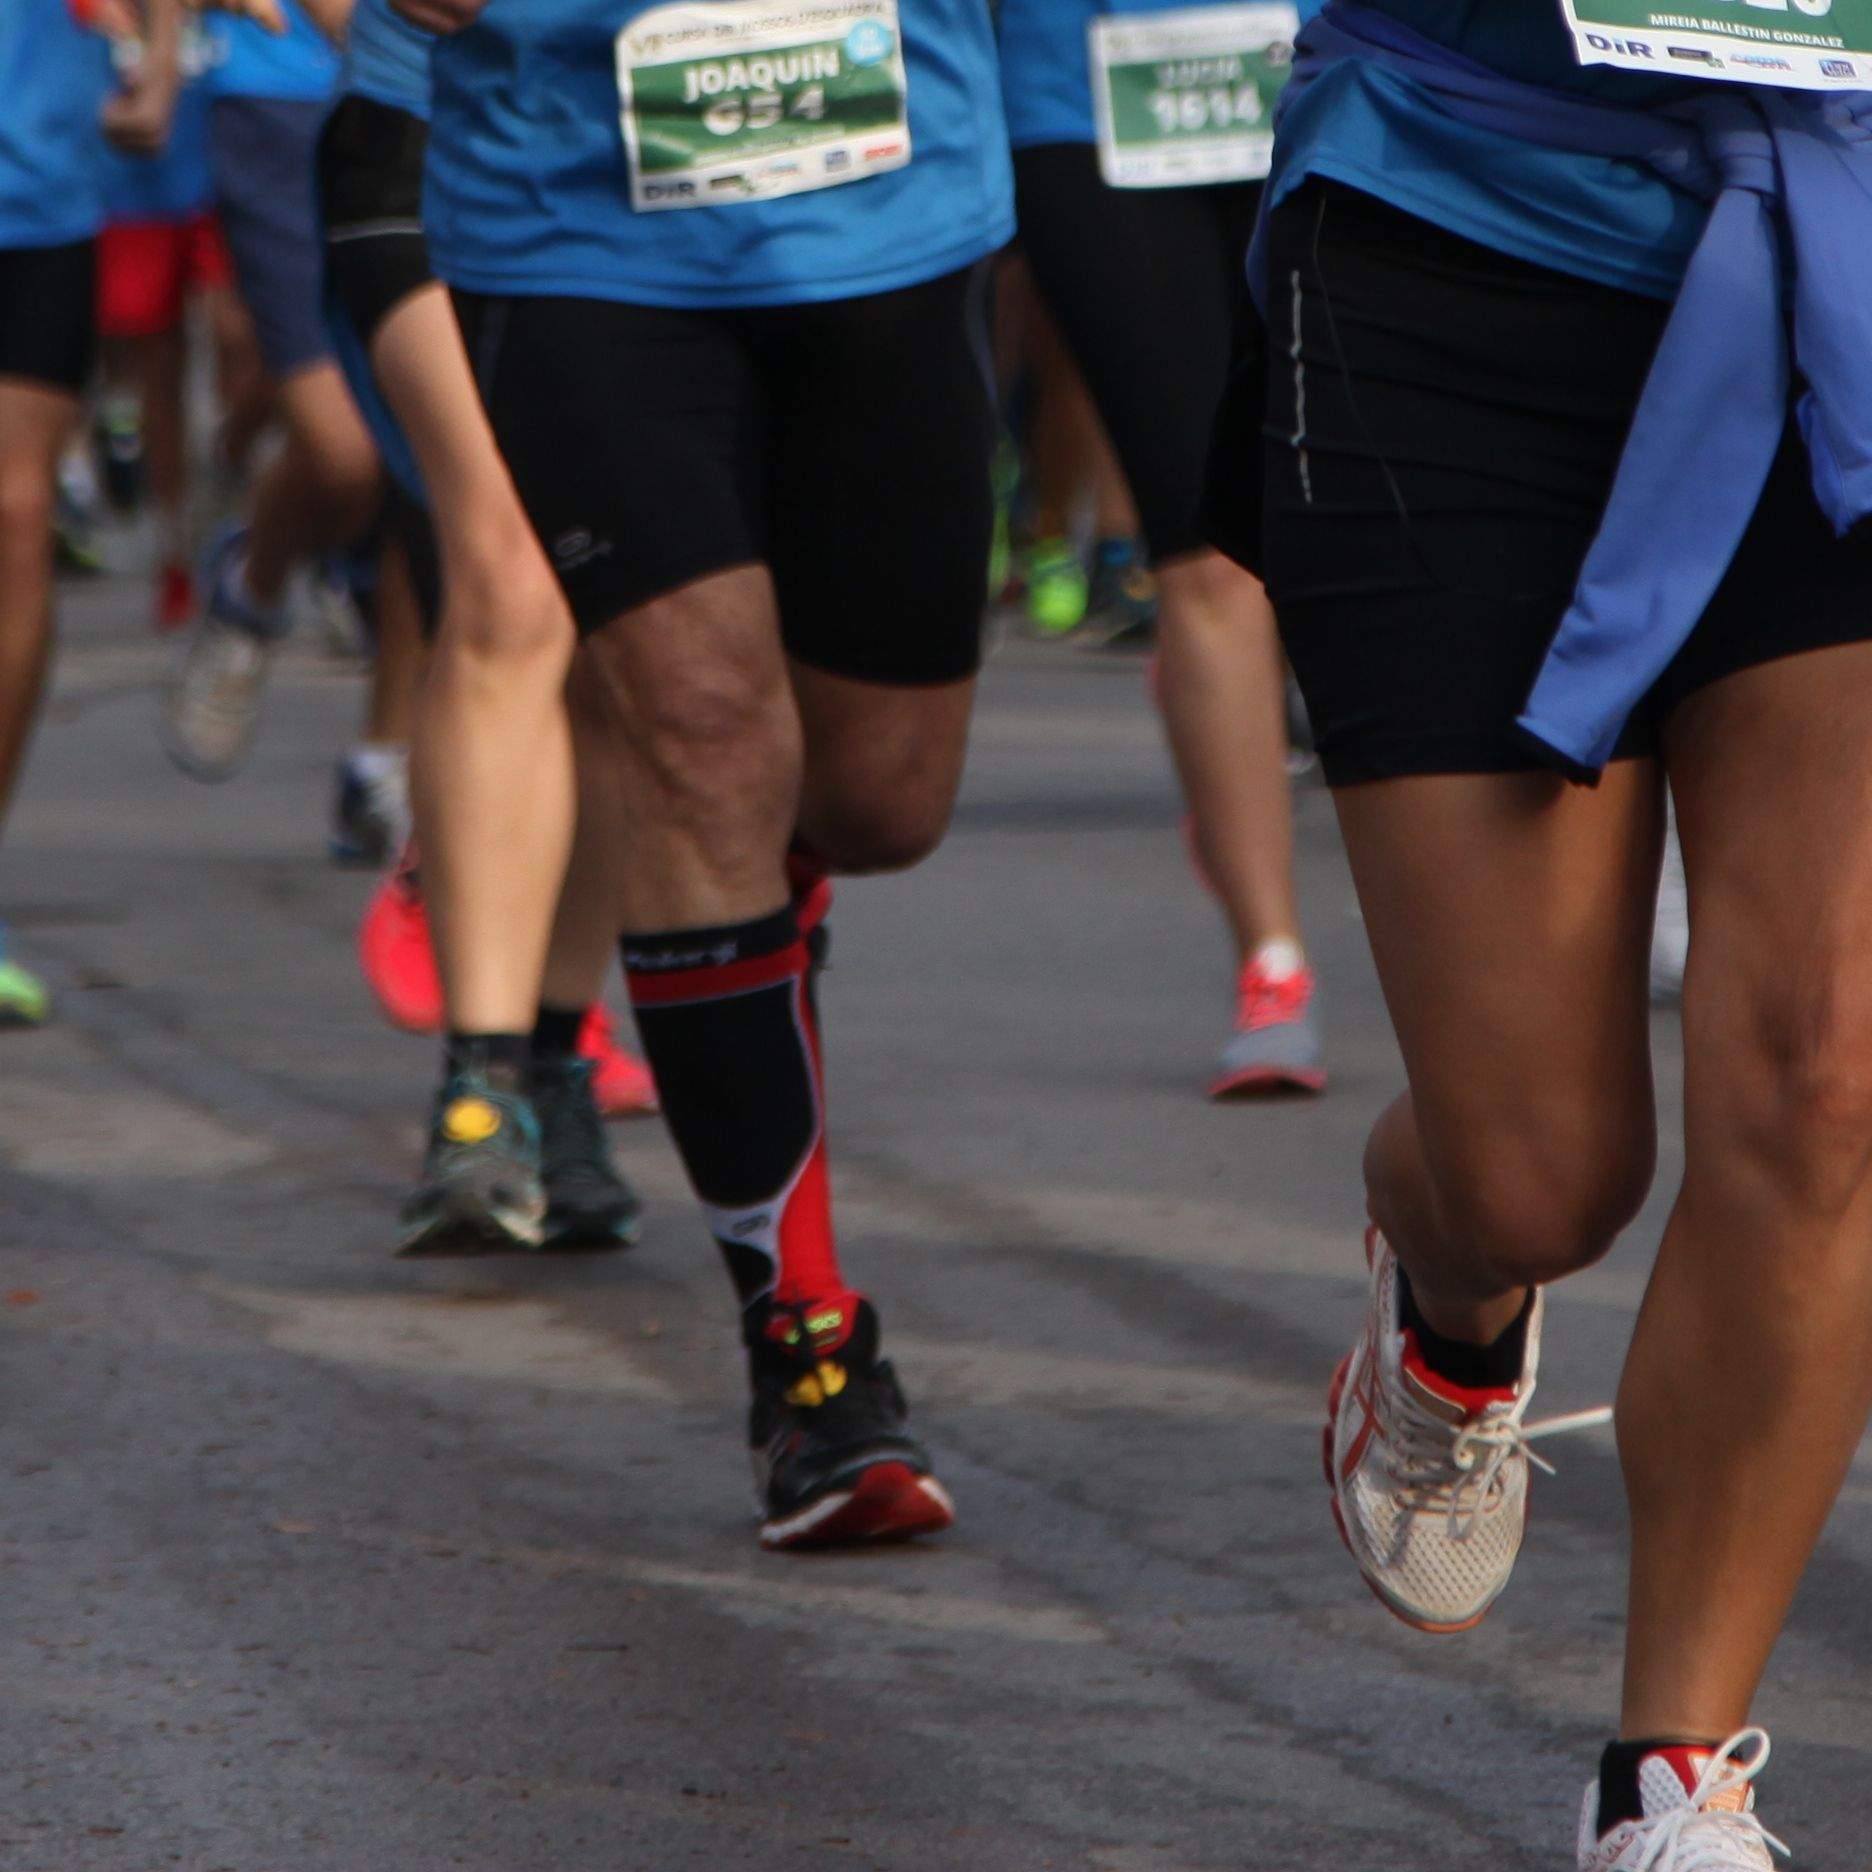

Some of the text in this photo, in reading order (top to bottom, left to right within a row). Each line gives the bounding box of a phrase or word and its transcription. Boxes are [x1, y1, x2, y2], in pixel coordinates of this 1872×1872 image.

[1649, 13, 1844, 49] MIREIA BALLESTIN GONZALEZ
[683, 48, 840, 103] JOAQUIN
